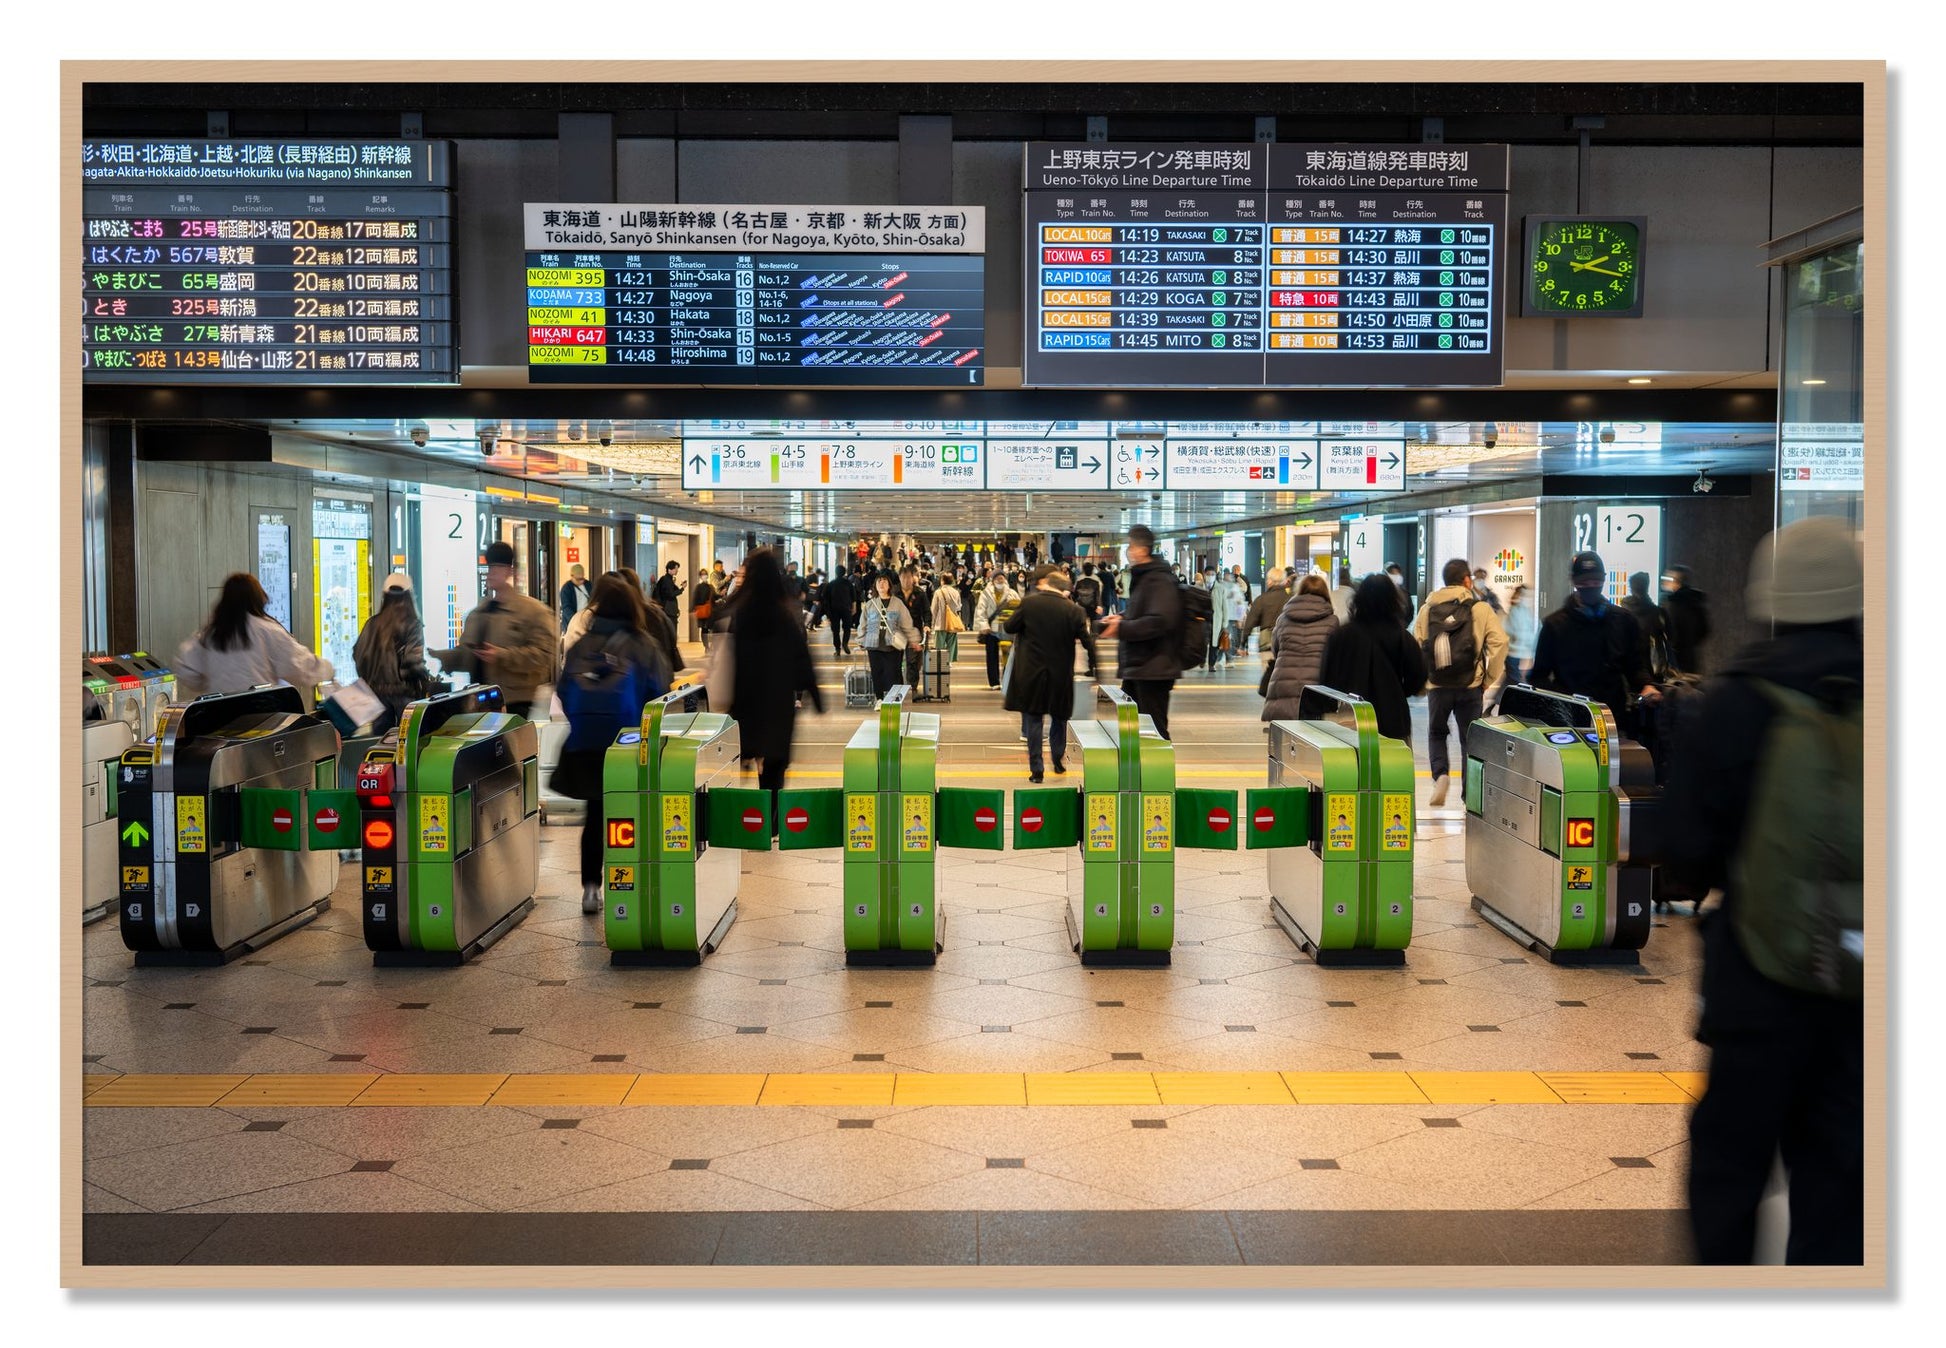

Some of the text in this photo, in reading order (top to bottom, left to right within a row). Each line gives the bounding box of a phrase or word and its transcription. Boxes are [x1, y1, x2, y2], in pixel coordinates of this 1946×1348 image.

[1043, 150, 1250, 170] 上野東京ライン発車時刻
[1306, 152, 1468, 172] 東海道線発車時刻
[286, 168, 304, 180] (via
[308, 168, 351, 181] Nagano)
[354, 168, 412, 179] Shinkansen
[1043, 175, 1252, 188] Ueno-Tōkyō Line Departure Time
[1296, 176, 1478, 188] Tōkaidō Line Departure Time
[89, 220, 164, 238] はやぶさ・こまち
[181, 221, 217, 237] 25号
[292, 220, 344, 240] 20番線
[346, 222, 417, 238] 17両編成
[1045, 229, 1084, 242] LOCAL
[1120, 228, 1159, 242] 14:19
[1166, 231, 1206, 240] TAKASAKI
[1234, 229, 1242, 242] 7
[1280, 230, 1306, 242] 普通
[1314, 230, 1340, 242] 15両
[1348, 230, 1387, 242] 14:27
[1394, 230, 1422, 242] 熱海
[1576, 228, 1592, 240] 12
[546, 231, 965, 248] Tōkaidō, Sanyō Shinkansen (for Nagoya, Kyōto, Shin-Ōsaka)
[92, 246, 418, 266] はくたか 567号 敦賀 22番線 12両編成
[1046, 250, 1242, 263] TOKIWA 65 14:23 KATSUTA 8
[1546, 244, 1561, 255] 10
[882, 263, 900, 271] Stops
[1538, 261, 1548, 272] 9
[1618, 262, 1628, 272] 3
[529, 270, 572, 280] NOZOMI
[576, 272, 602, 284] 395
[614, 272, 652, 284] 14:21
[669, 270, 730, 280] Shin-Ōsaka
[738, 272, 752, 286] 16
[759, 276, 790, 286] No.1,2
[530, 290, 752, 306] KODAMA 733 14:27 Nagoya 19
[1279, 292, 1304, 306] 特急
[1313, 294, 1338, 304] 10両
[1346, 292, 1386, 306] 14:43
[1394, 293, 1420, 306] 品川
[1576, 294, 1586, 305] 6
[530, 309, 790, 326] NOZOMI 41 14:30 Hakata 18 No.1,2
[1279, 314, 1304, 326] 普通
[1313, 314, 1338, 326] 15両
[1346, 314, 1386, 327] 14:50
[1392, 314, 1432, 328] 小田原
[94, 324, 419, 344] はやぶさ 27号 新青森 21番線 10両編成
[532, 328, 791, 344] HIKARI 647 14:33 Shin-Ōsaka 15 No.1-5
[1045, 336, 1083, 346] RAPID
[1118, 334, 1158, 346] 14:45
[1166, 335, 1201, 346] MITO
[1232, 334, 1242, 347] 8
[94, 350, 166, 368] やまびこ・つばさ
[174, 351, 220, 368] 143号
[295, 350, 346, 370] 21番線
[348, 352, 419, 368] 17両編成
[532, 348, 752, 364] NOZOMI 75 14:48 Hiroshima 19
[722, 444, 746, 458] 3·6
[782, 444, 806, 458] 4·5
[832, 444, 856, 458] 7·8
[904, 444, 936, 458] 9·10
[1331, 446, 1362, 456] 京葉線
[942, 466, 974, 476] 新幹線
[394, 506, 402, 549] 1
[448, 514, 462, 538] 2
[479, 513, 487, 550] 2
[1604, 514, 1645, 542] 1·2
[1356, 532, 1366, 548] 4
[1418, 525, 1424, 555] 3
[1228, 542, 1234, 554] 6
[1494, 575, 1524, 583] GRANSTA
[360, 779, 378, 790] QR
[610, 823, 634, 846] IC
[1570, 822, 1592, 845] IC
[132, 906, 139, 914] 8
[376, 906, 382, 914] 7
[432, 906, 438, 915] 6
[674, 906, 680, 914] 5
[912, 906, 919, 914] 4
[1153, 906, 1159, 914] 3
[1632, 905, 1636, 914] 1
